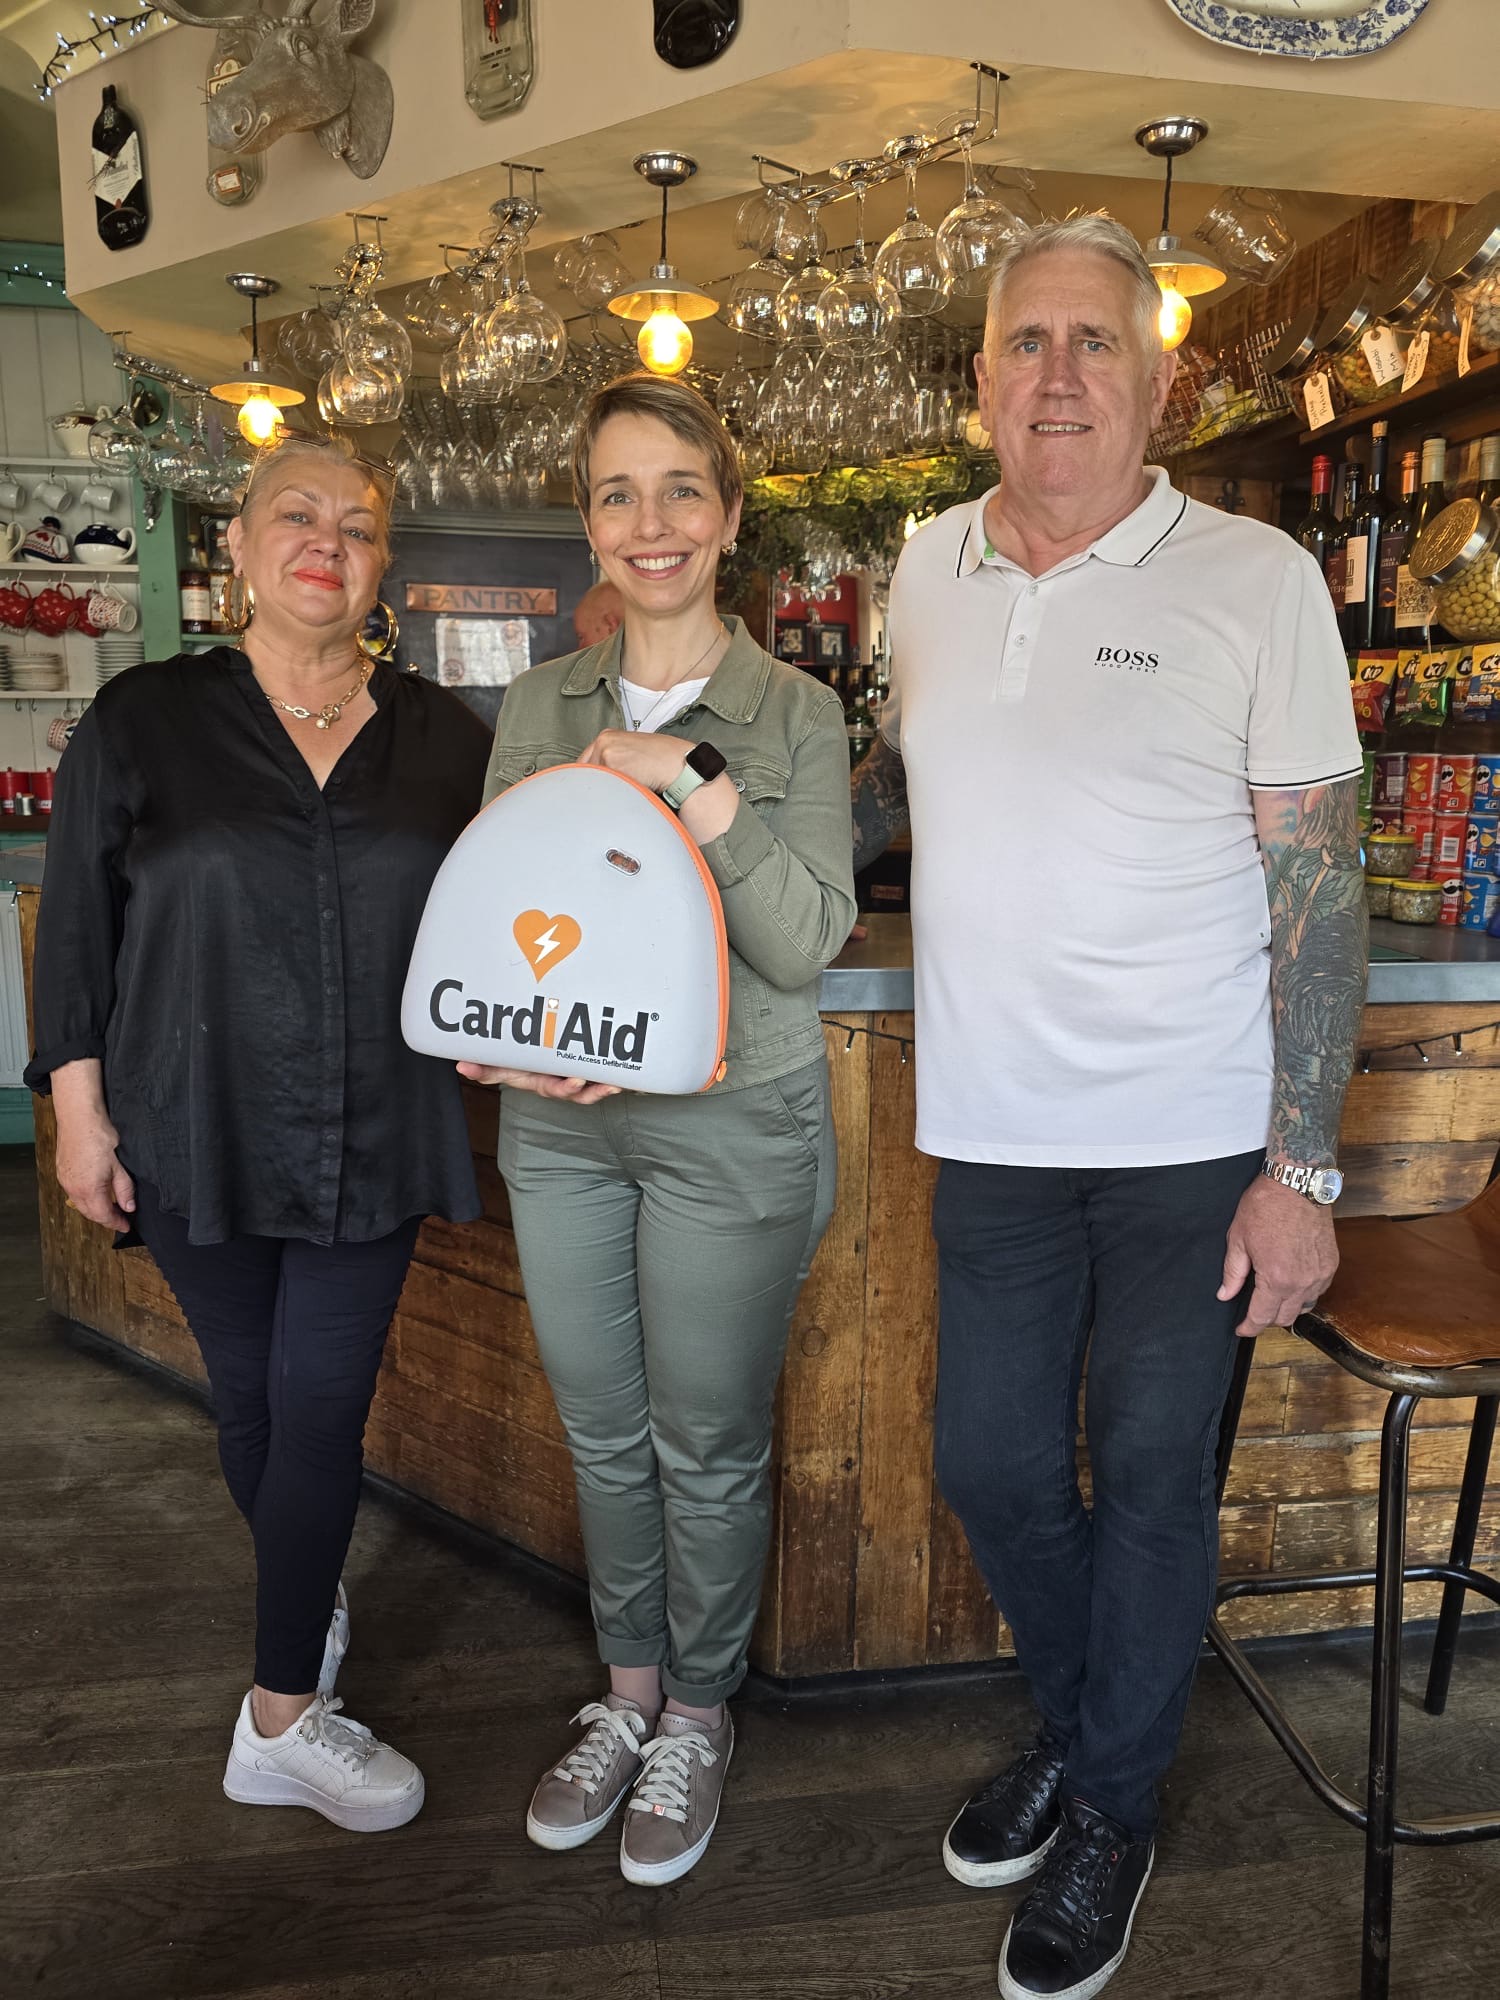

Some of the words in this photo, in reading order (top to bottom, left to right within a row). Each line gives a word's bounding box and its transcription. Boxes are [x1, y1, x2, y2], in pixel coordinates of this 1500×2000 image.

[1389, 351, 1399, 372] Mix
[424, 587, 542, 610] PANTRY
[1096, 647, 1159, 668] BOSS
[1363, 665, 1382, 680] KP
[556, 1050, 577, 1061] Public
[578, 1055, 601, 1065] Access
[602, 1058, 643, 1071] Defibrillator
